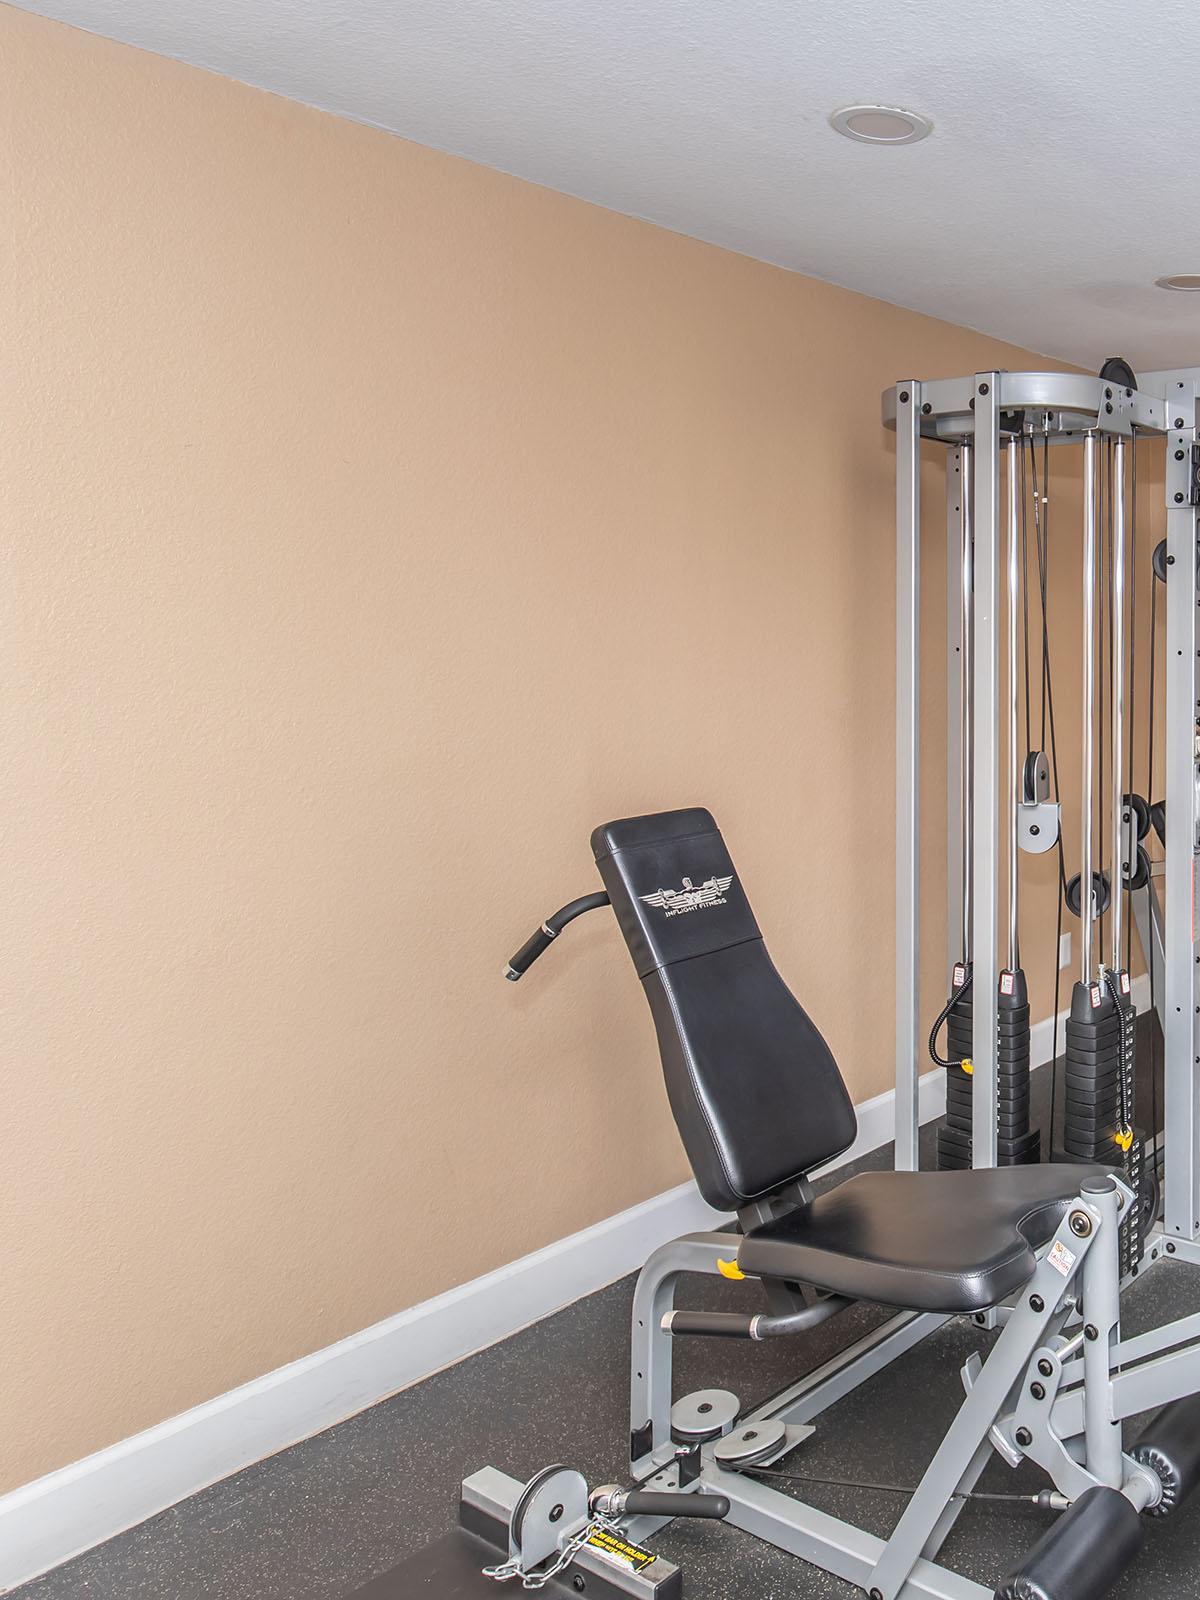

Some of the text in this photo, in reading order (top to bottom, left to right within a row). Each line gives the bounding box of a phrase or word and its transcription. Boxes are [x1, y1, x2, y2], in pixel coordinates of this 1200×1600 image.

[665, 898, 727, 917] INFLIGHT FITNESS
[604, 1536, 618, 1546] BAR
[615, 1542, 627, 1550] ON
[624, 1546, 648, 1561] HOLDER
